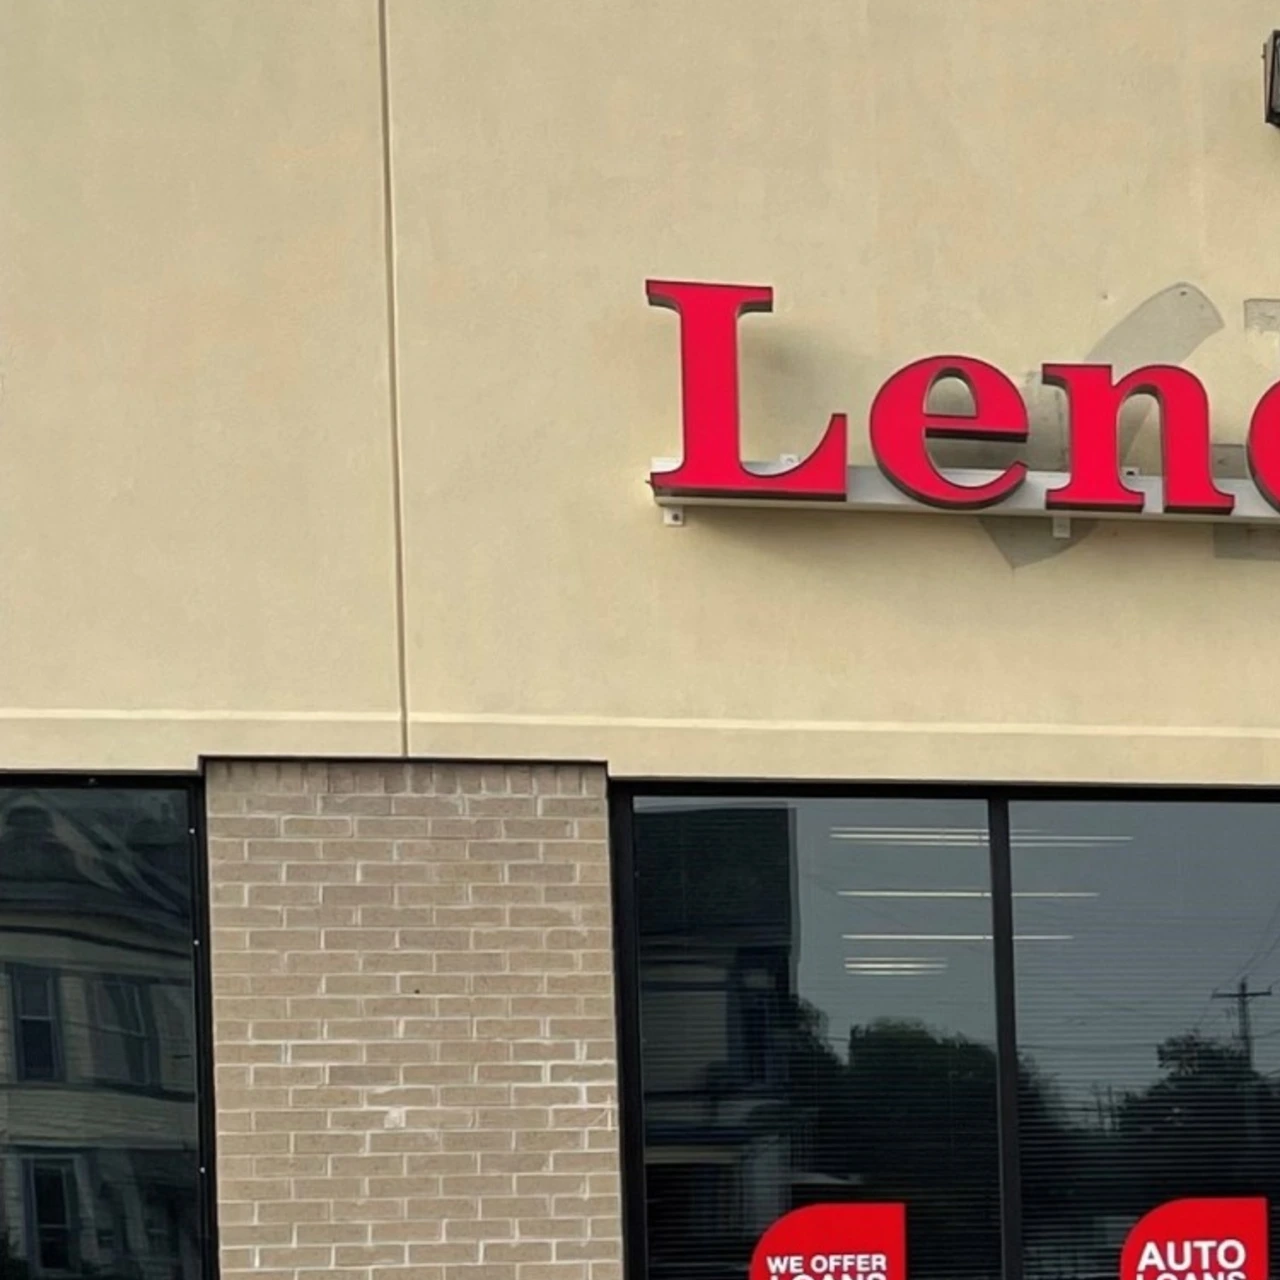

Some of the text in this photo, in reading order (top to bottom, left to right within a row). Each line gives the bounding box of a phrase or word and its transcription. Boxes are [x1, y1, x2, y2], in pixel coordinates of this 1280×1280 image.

[767, 1254, 888, 1274] WE OFFER
[1137, 1239, 1247, 1271] AUTO
